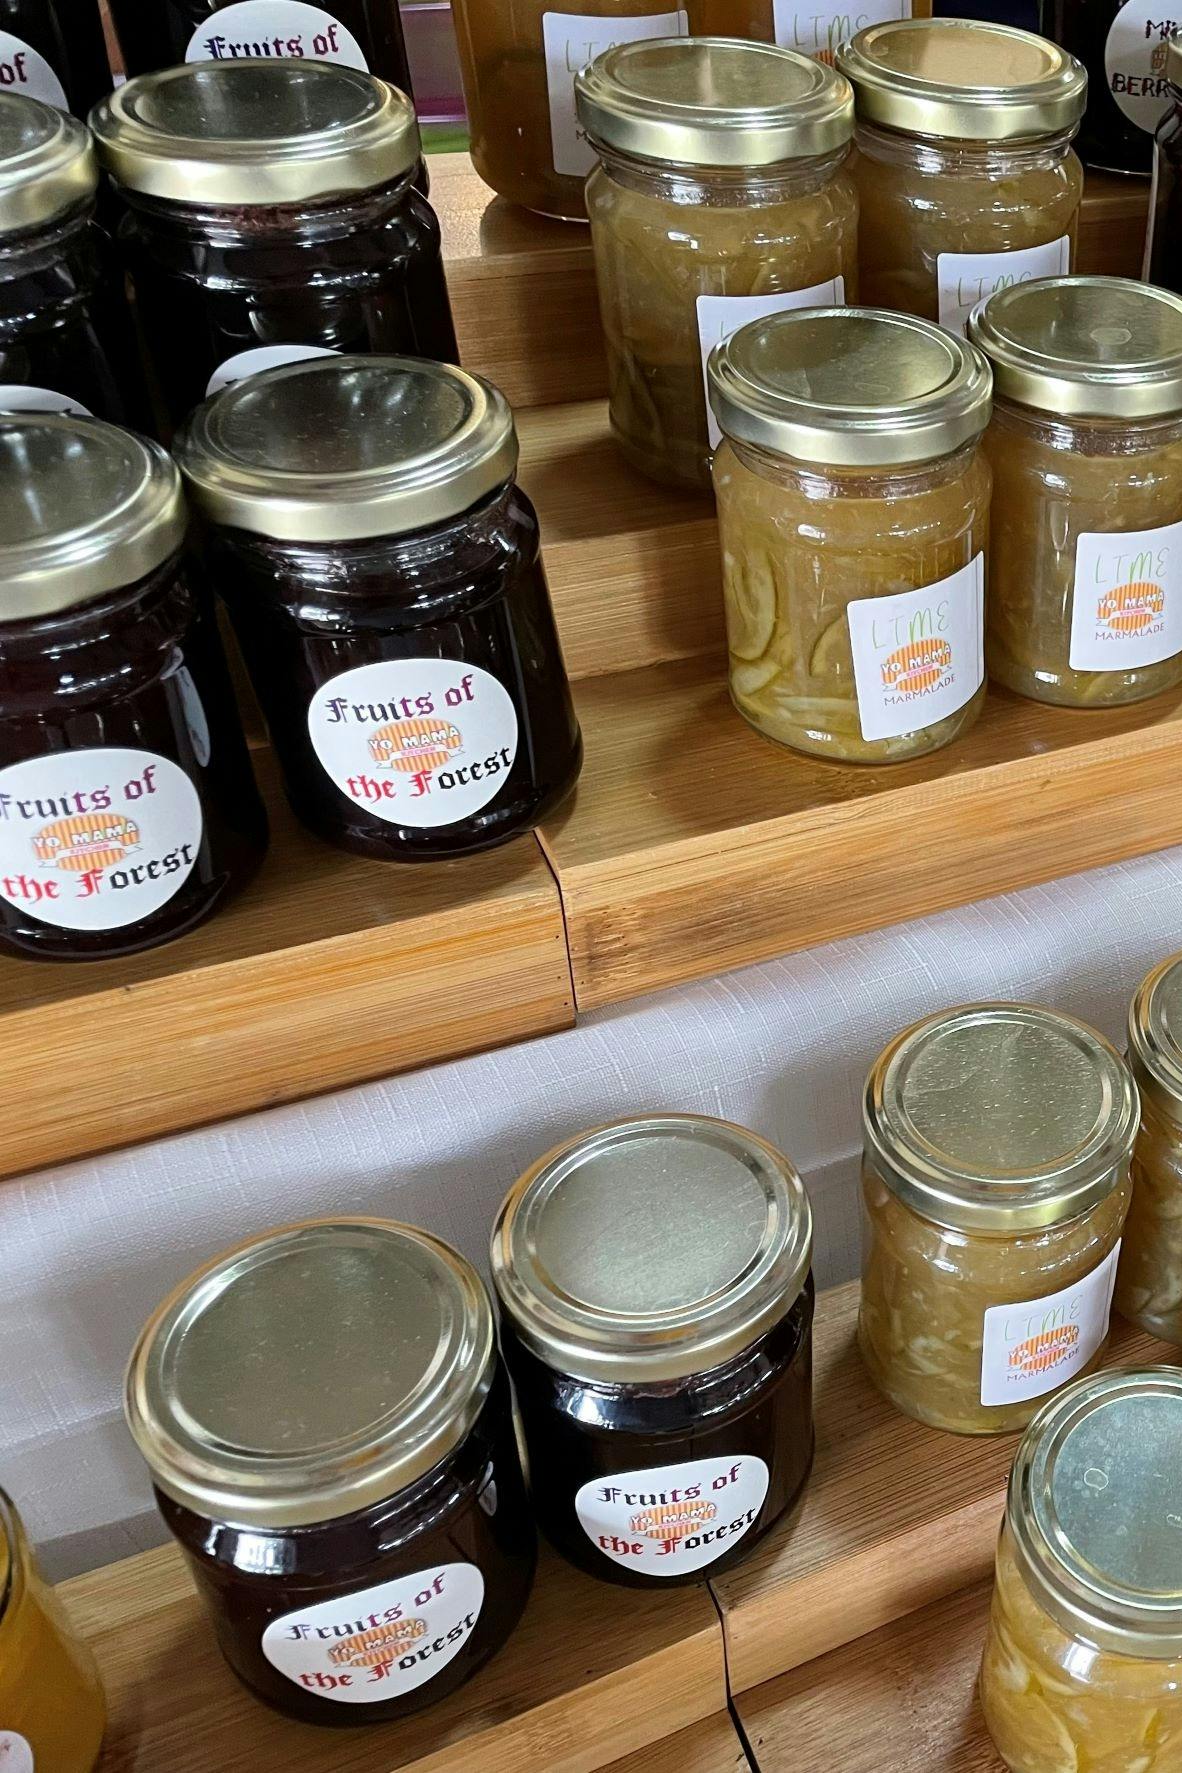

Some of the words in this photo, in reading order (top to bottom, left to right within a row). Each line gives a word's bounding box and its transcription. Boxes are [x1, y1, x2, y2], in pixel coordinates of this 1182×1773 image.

[202, 35, 304, 60] Fruits
[312, 23, 340, 56] of
[1111, 72, 1170, 98] BERR
[1098, 598, 1117, 610] YO
[1124, 591, 1165, 609] MAMA
[1095, 622, 1165, 641] MARMALADE
[880, 662, 902, 674] YO
[909, 644, 952, 669] MAMA
[325, 692, 434, 723] Fruits
[444, 673, 475, 708] of
[884, 673, 958, 706] MARMALADE
[368, 738, 394, 751] YO
[401, 726, 460, 749] MAMA
[0, 784, 111, 821] Fruits
[124, 764, 158, 801] of
[346, 775, 397, 804] the
[408, 747, 513, 797] Forest
[32, 836, 61, 849] YO
[72, 820, 139, 846] MAMA
[3, 874, 60, 905] the
[75, 843, 194, 898] Forest
[1007, 1346, 1080, 1383] MARMALADE
[1009, 1348, 1029, 1360] YO
[596, 1483, 702, 1505] Fruits
[712, 1462, 743, 1490] of
[598, 1535, 644, 1555] the
[655, 1508, 756, 1555] Forest
[631, 1516, 653, 1526] YO
[662, 1503, 717, 1523] MAMA
[285, 1603, 403, 1640] Fruits
[414, 1572, 446, 1607] of
[299, 1671, 354, 1690] the
[367, 1612, 475, 1683] Forest
[329, 1646, 356, 1658] YO
[365, 1621, 426, 1650] MAMA
